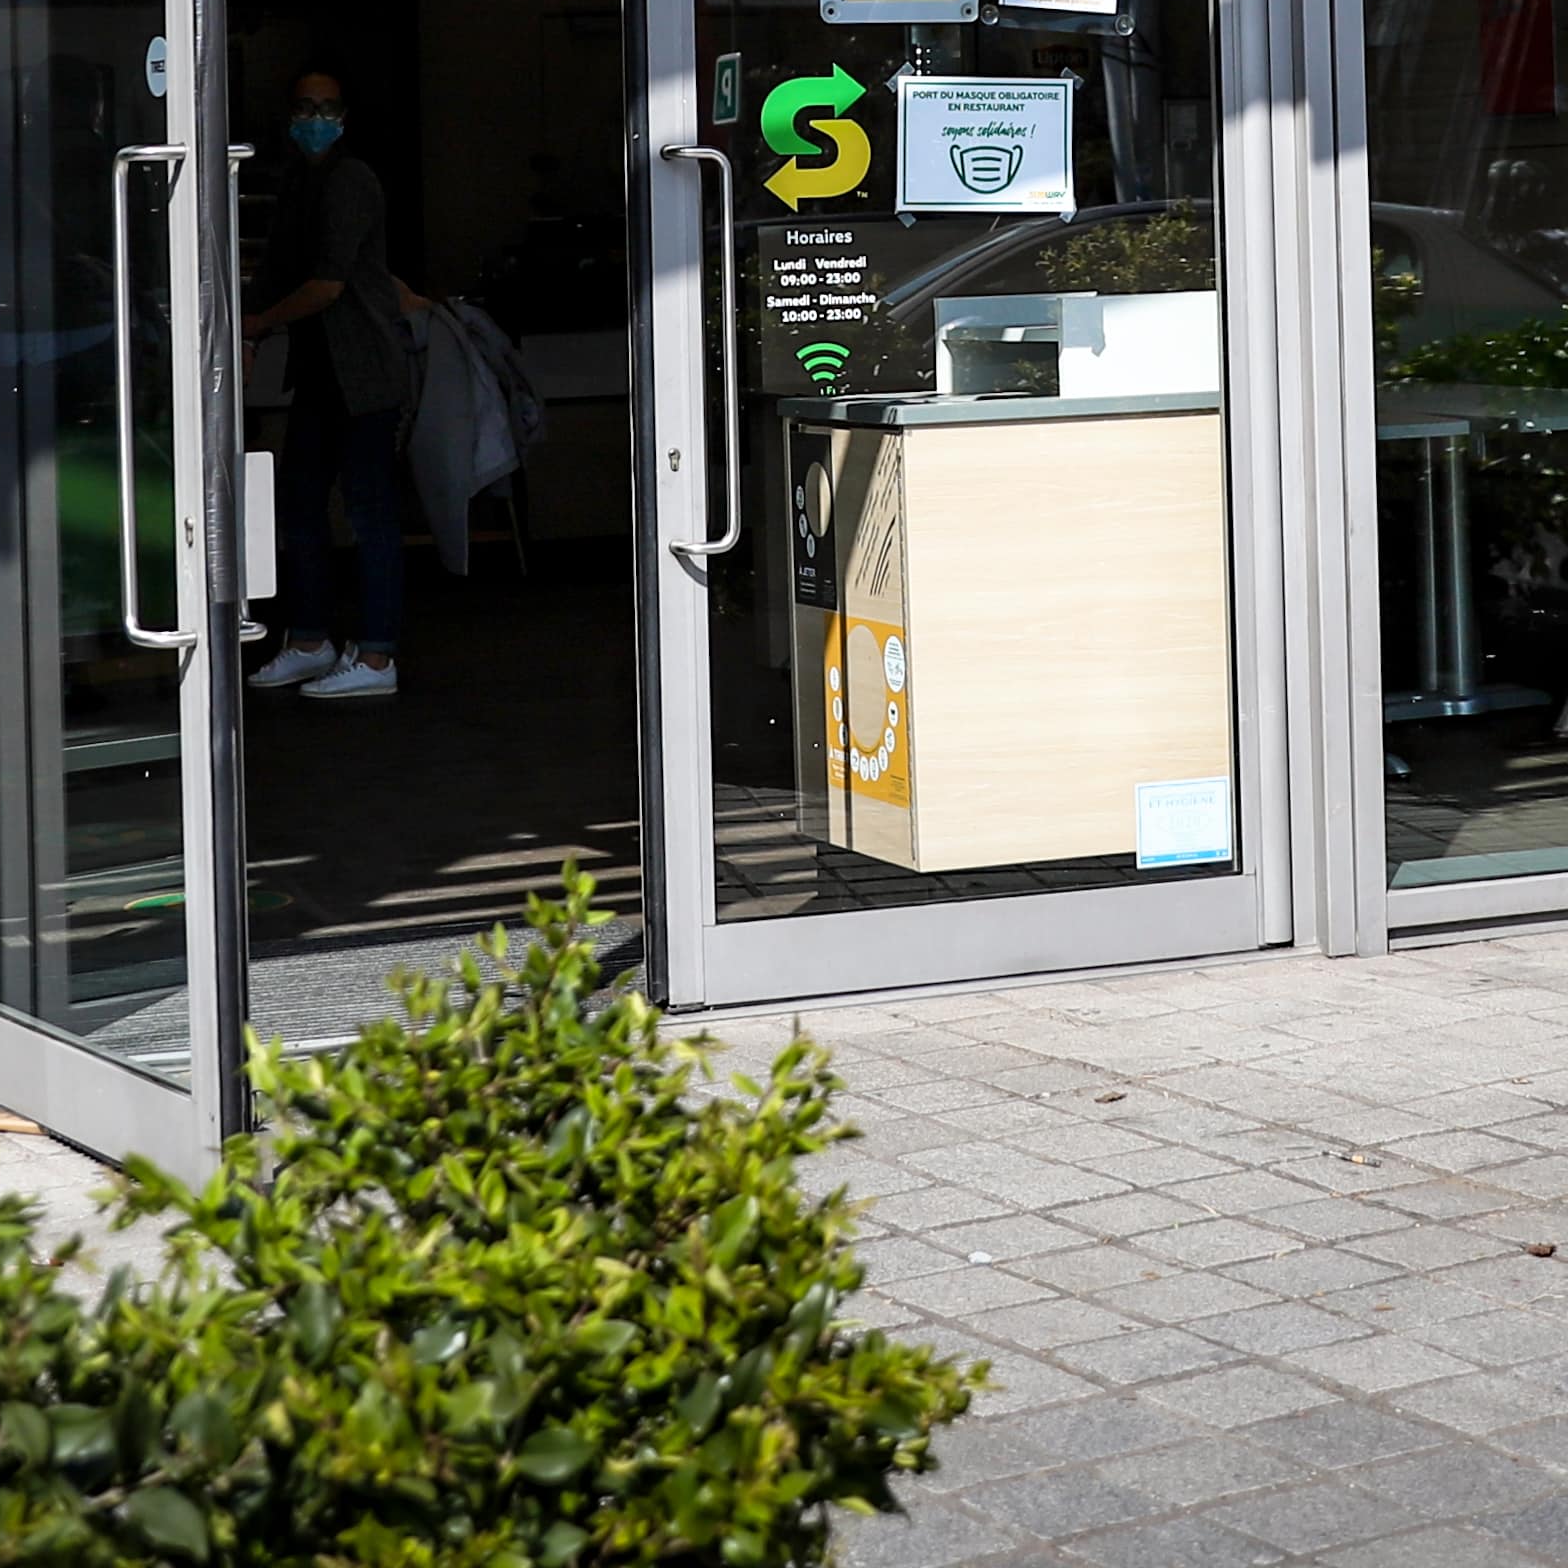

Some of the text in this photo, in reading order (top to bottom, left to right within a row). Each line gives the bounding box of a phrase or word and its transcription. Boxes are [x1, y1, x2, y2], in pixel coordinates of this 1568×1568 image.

[913, 91, 1060, 101] PORT DU MASQUE OBLIGATOIRE
[948, 103, 1025, 112] EN RESTAURANT
[941, 124, 974, 141] soyons
[977, 121, 1028, 138] solidaires
[786, 228, 853, 245] Horaires
[774, 256, 867, 271] Lundi Vendredi
[781, 273, 817, 287] 09:00
[826, 271, 861, 285] 23:00
[767, 294, 810, 308] Samedi
[820, 292, 876, 306] Dimanche
[782, 310, 818, 323] 10:00
[827, 308, 862, 321] 23:00
